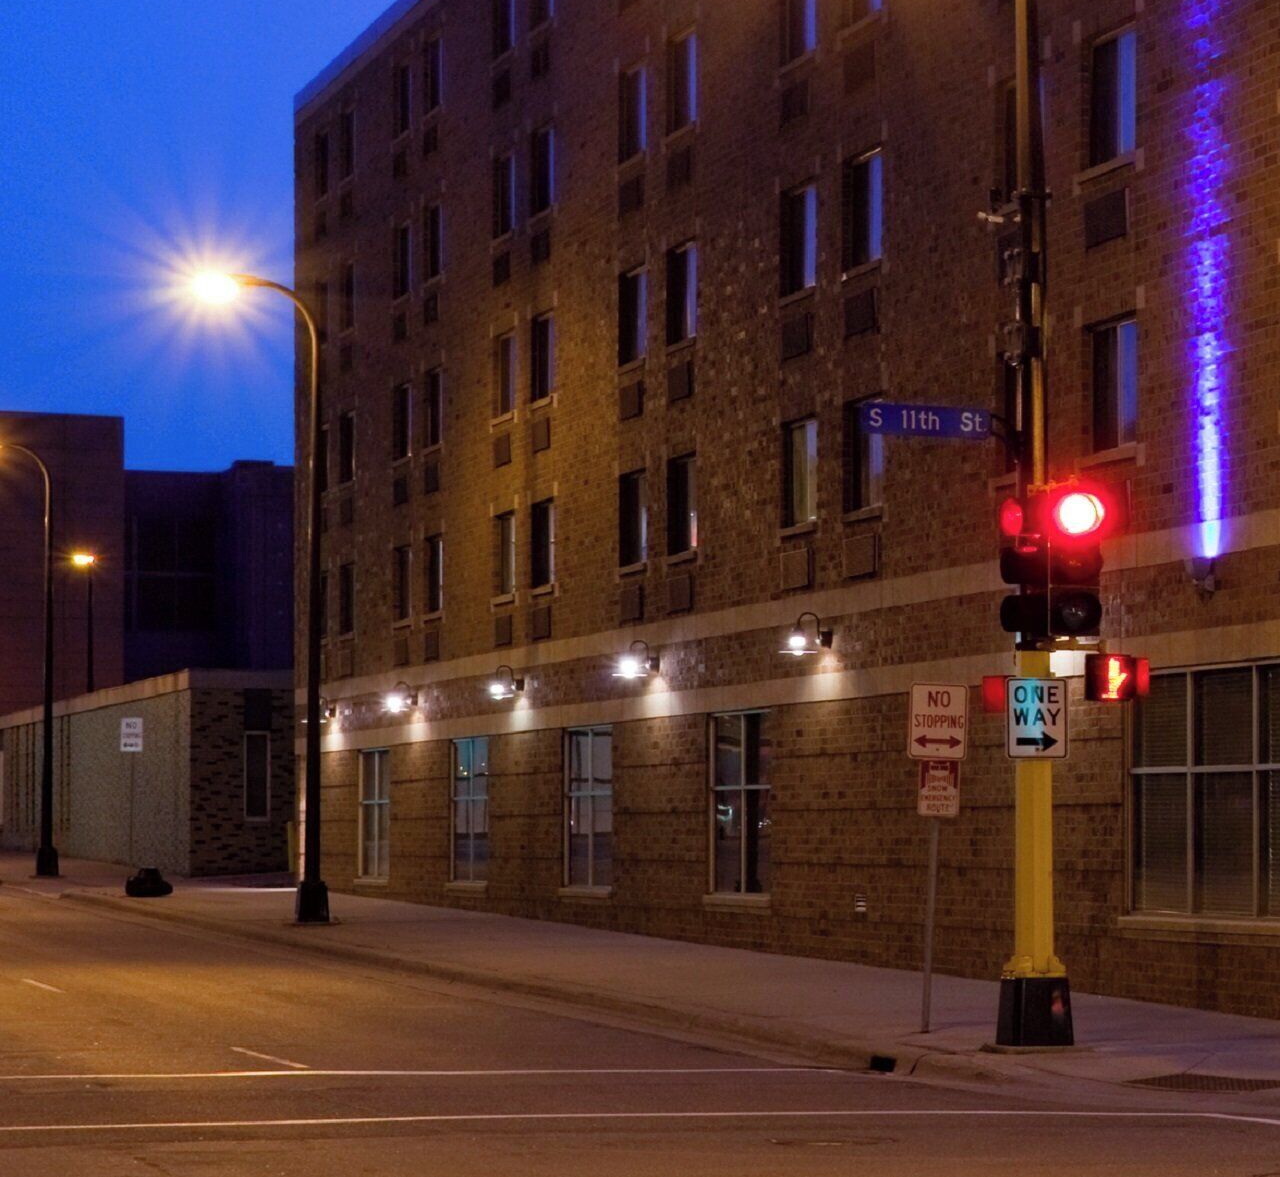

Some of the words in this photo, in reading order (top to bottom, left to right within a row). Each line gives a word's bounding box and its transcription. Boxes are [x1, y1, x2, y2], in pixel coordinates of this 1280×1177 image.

[869, 408, 883, 427] S
[901, 410, 940, 430] 11th
[927, 691, 951, 708] NO
[1014, 686, 1060, 703] ONE
[914, 714, 965, 729] STOPPING
[1014, 708, 1061, 726] WAY
